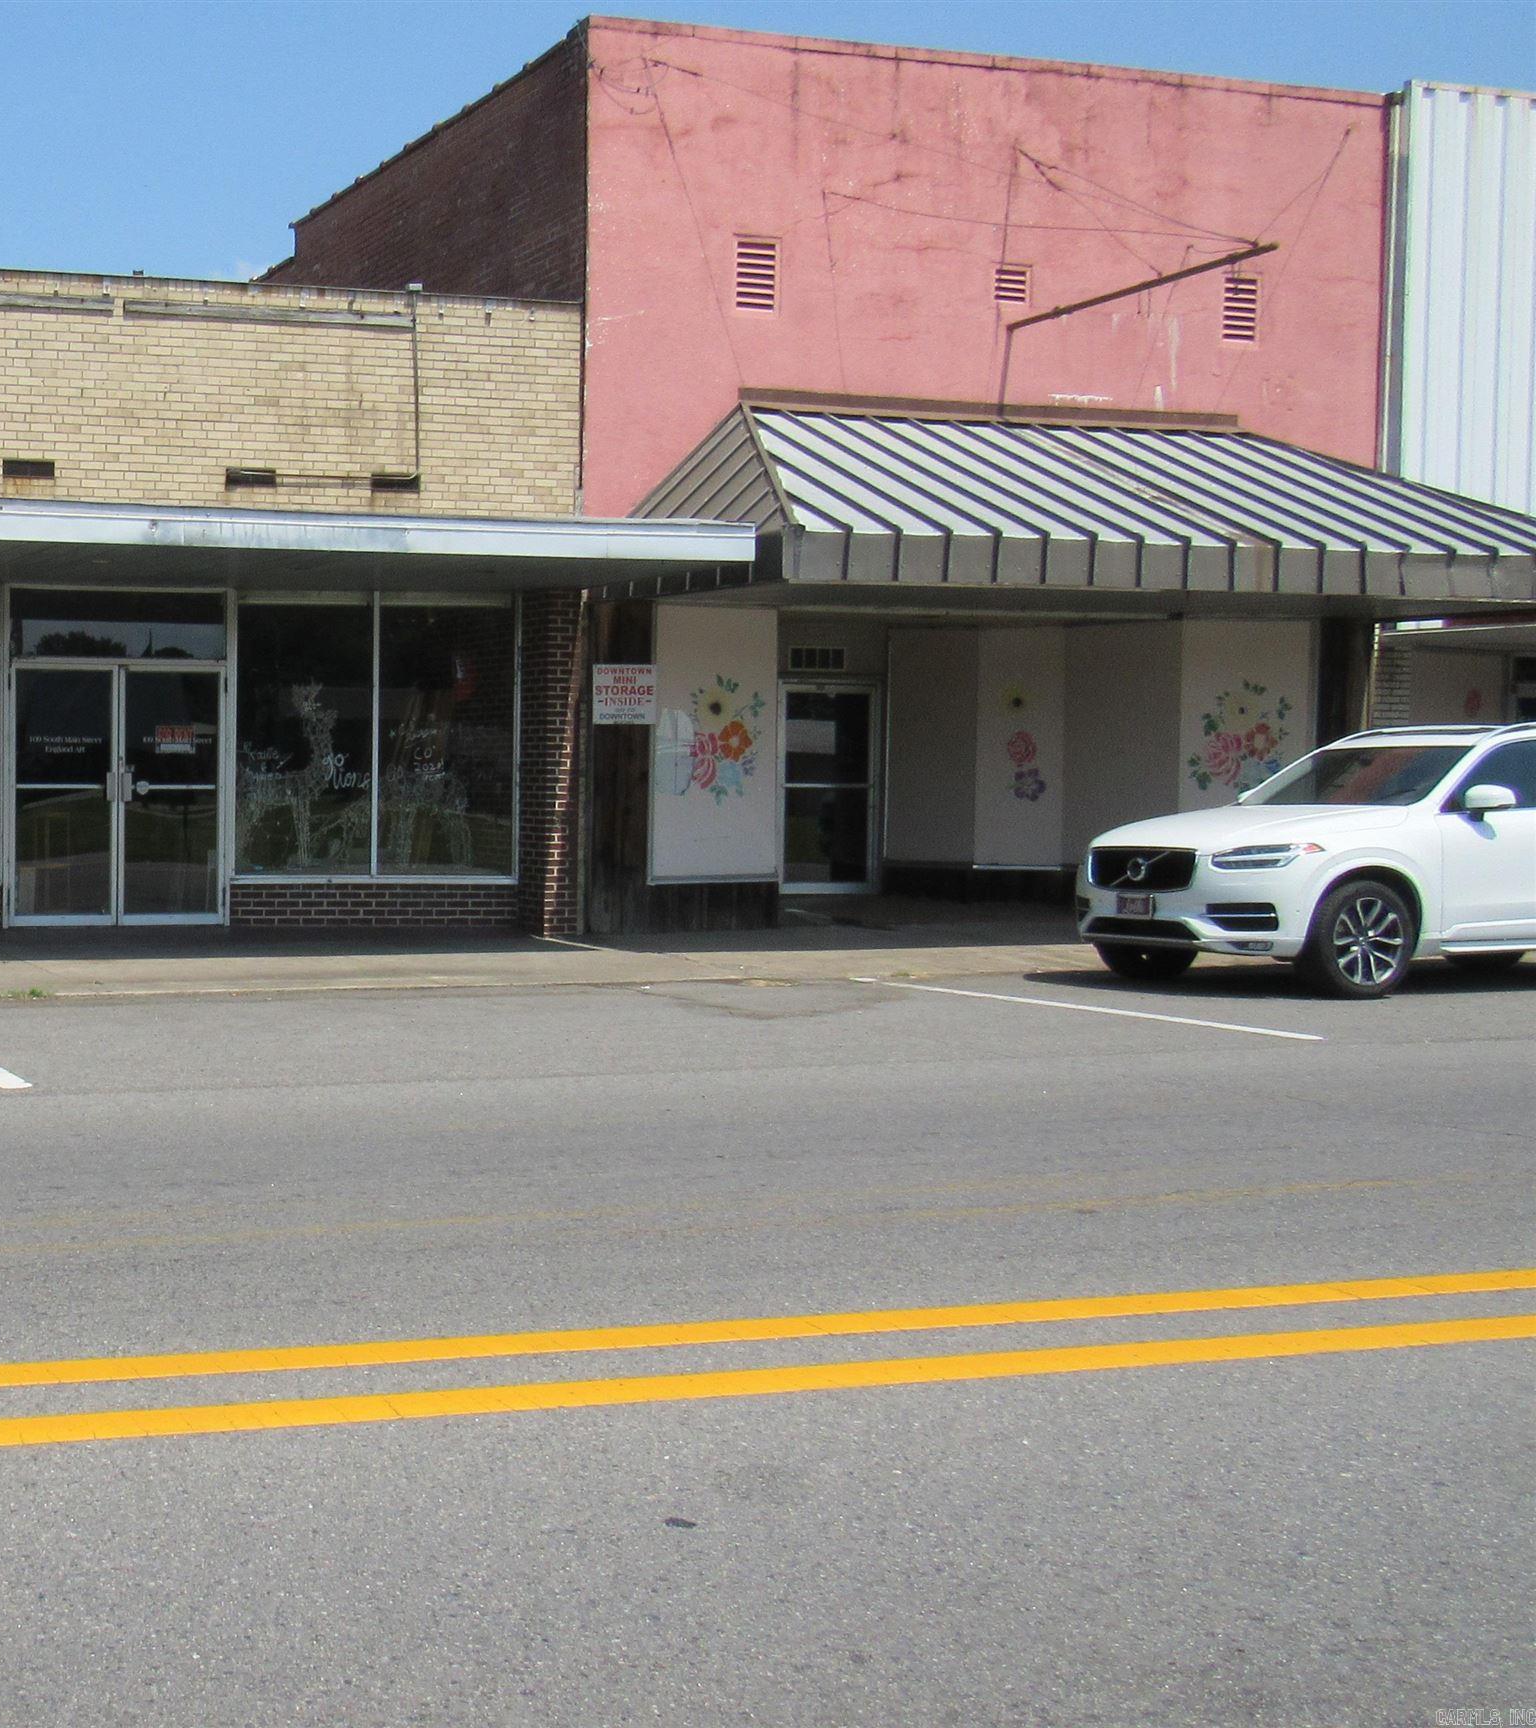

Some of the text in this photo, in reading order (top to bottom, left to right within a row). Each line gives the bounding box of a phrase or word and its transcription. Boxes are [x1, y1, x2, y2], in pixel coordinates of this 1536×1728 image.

[597, 667, 652, 675] DOWNTOWN
[613, 676, 637, 684] MINI
[595, 685, 654, 696] STORAGE
